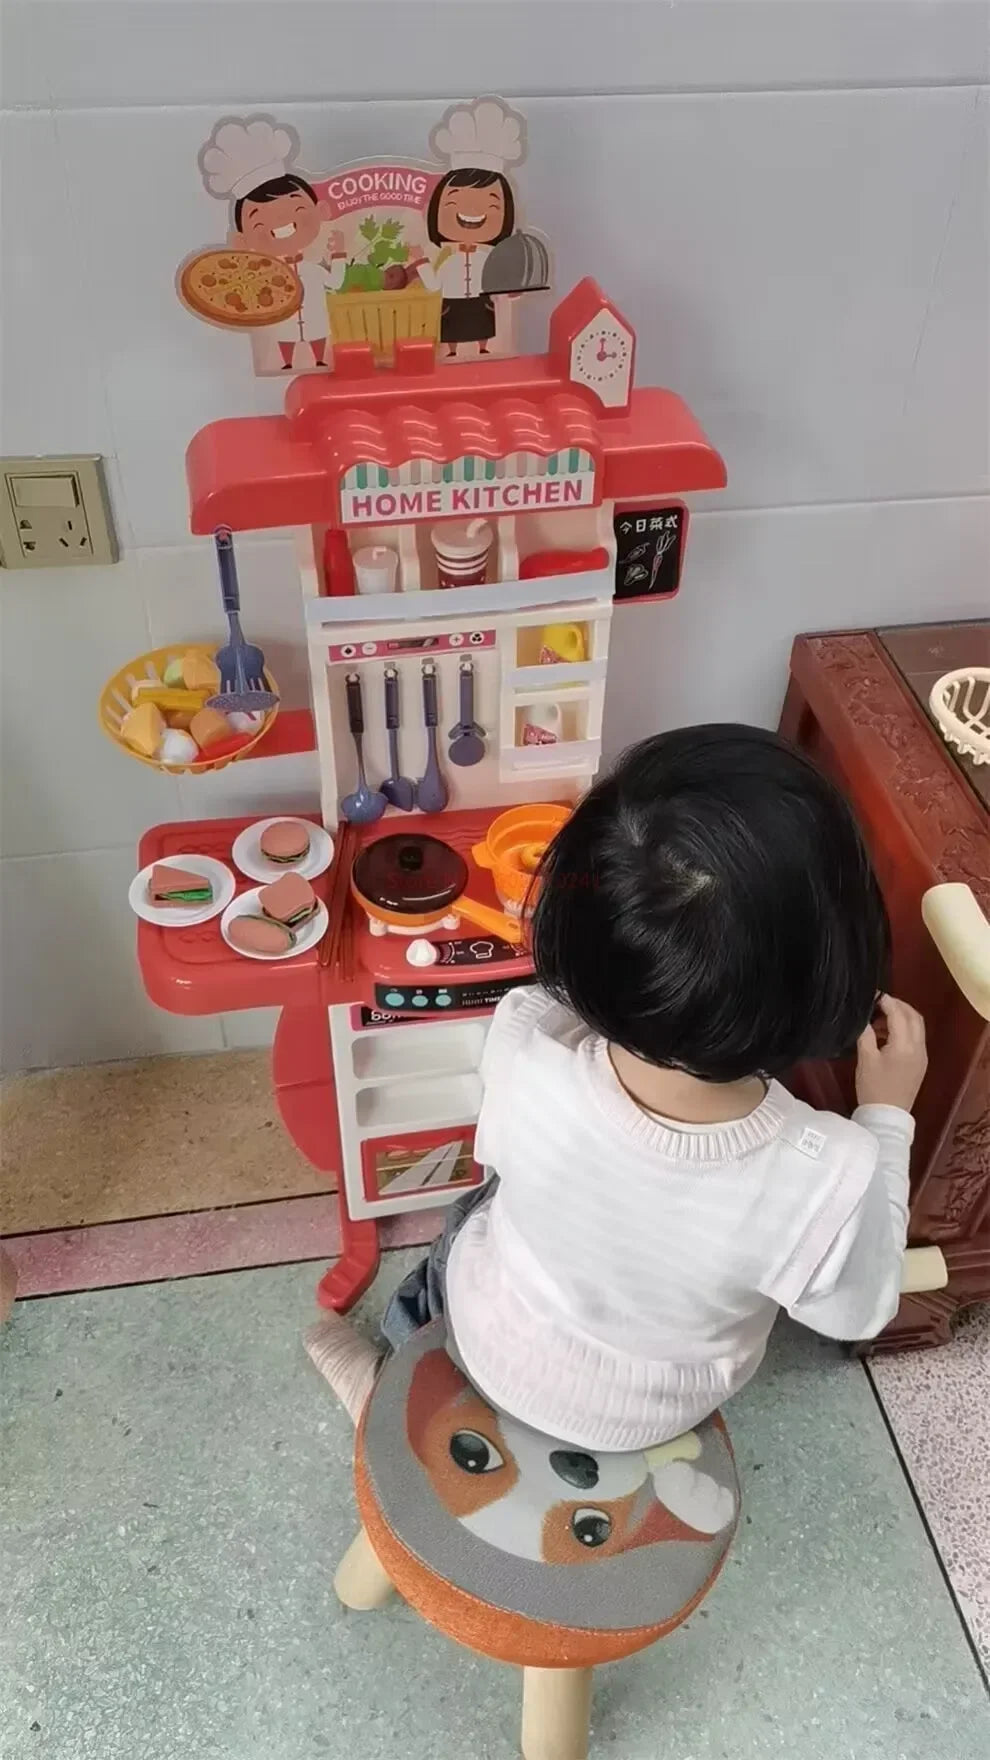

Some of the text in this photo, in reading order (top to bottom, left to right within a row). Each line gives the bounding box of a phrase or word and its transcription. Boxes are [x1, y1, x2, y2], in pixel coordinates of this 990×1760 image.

[328, 172, 427, 200] COOKING
[352, 479, 582, 517] HOME KITCHEN
[619, 514, 678, 535] 今日菜式
